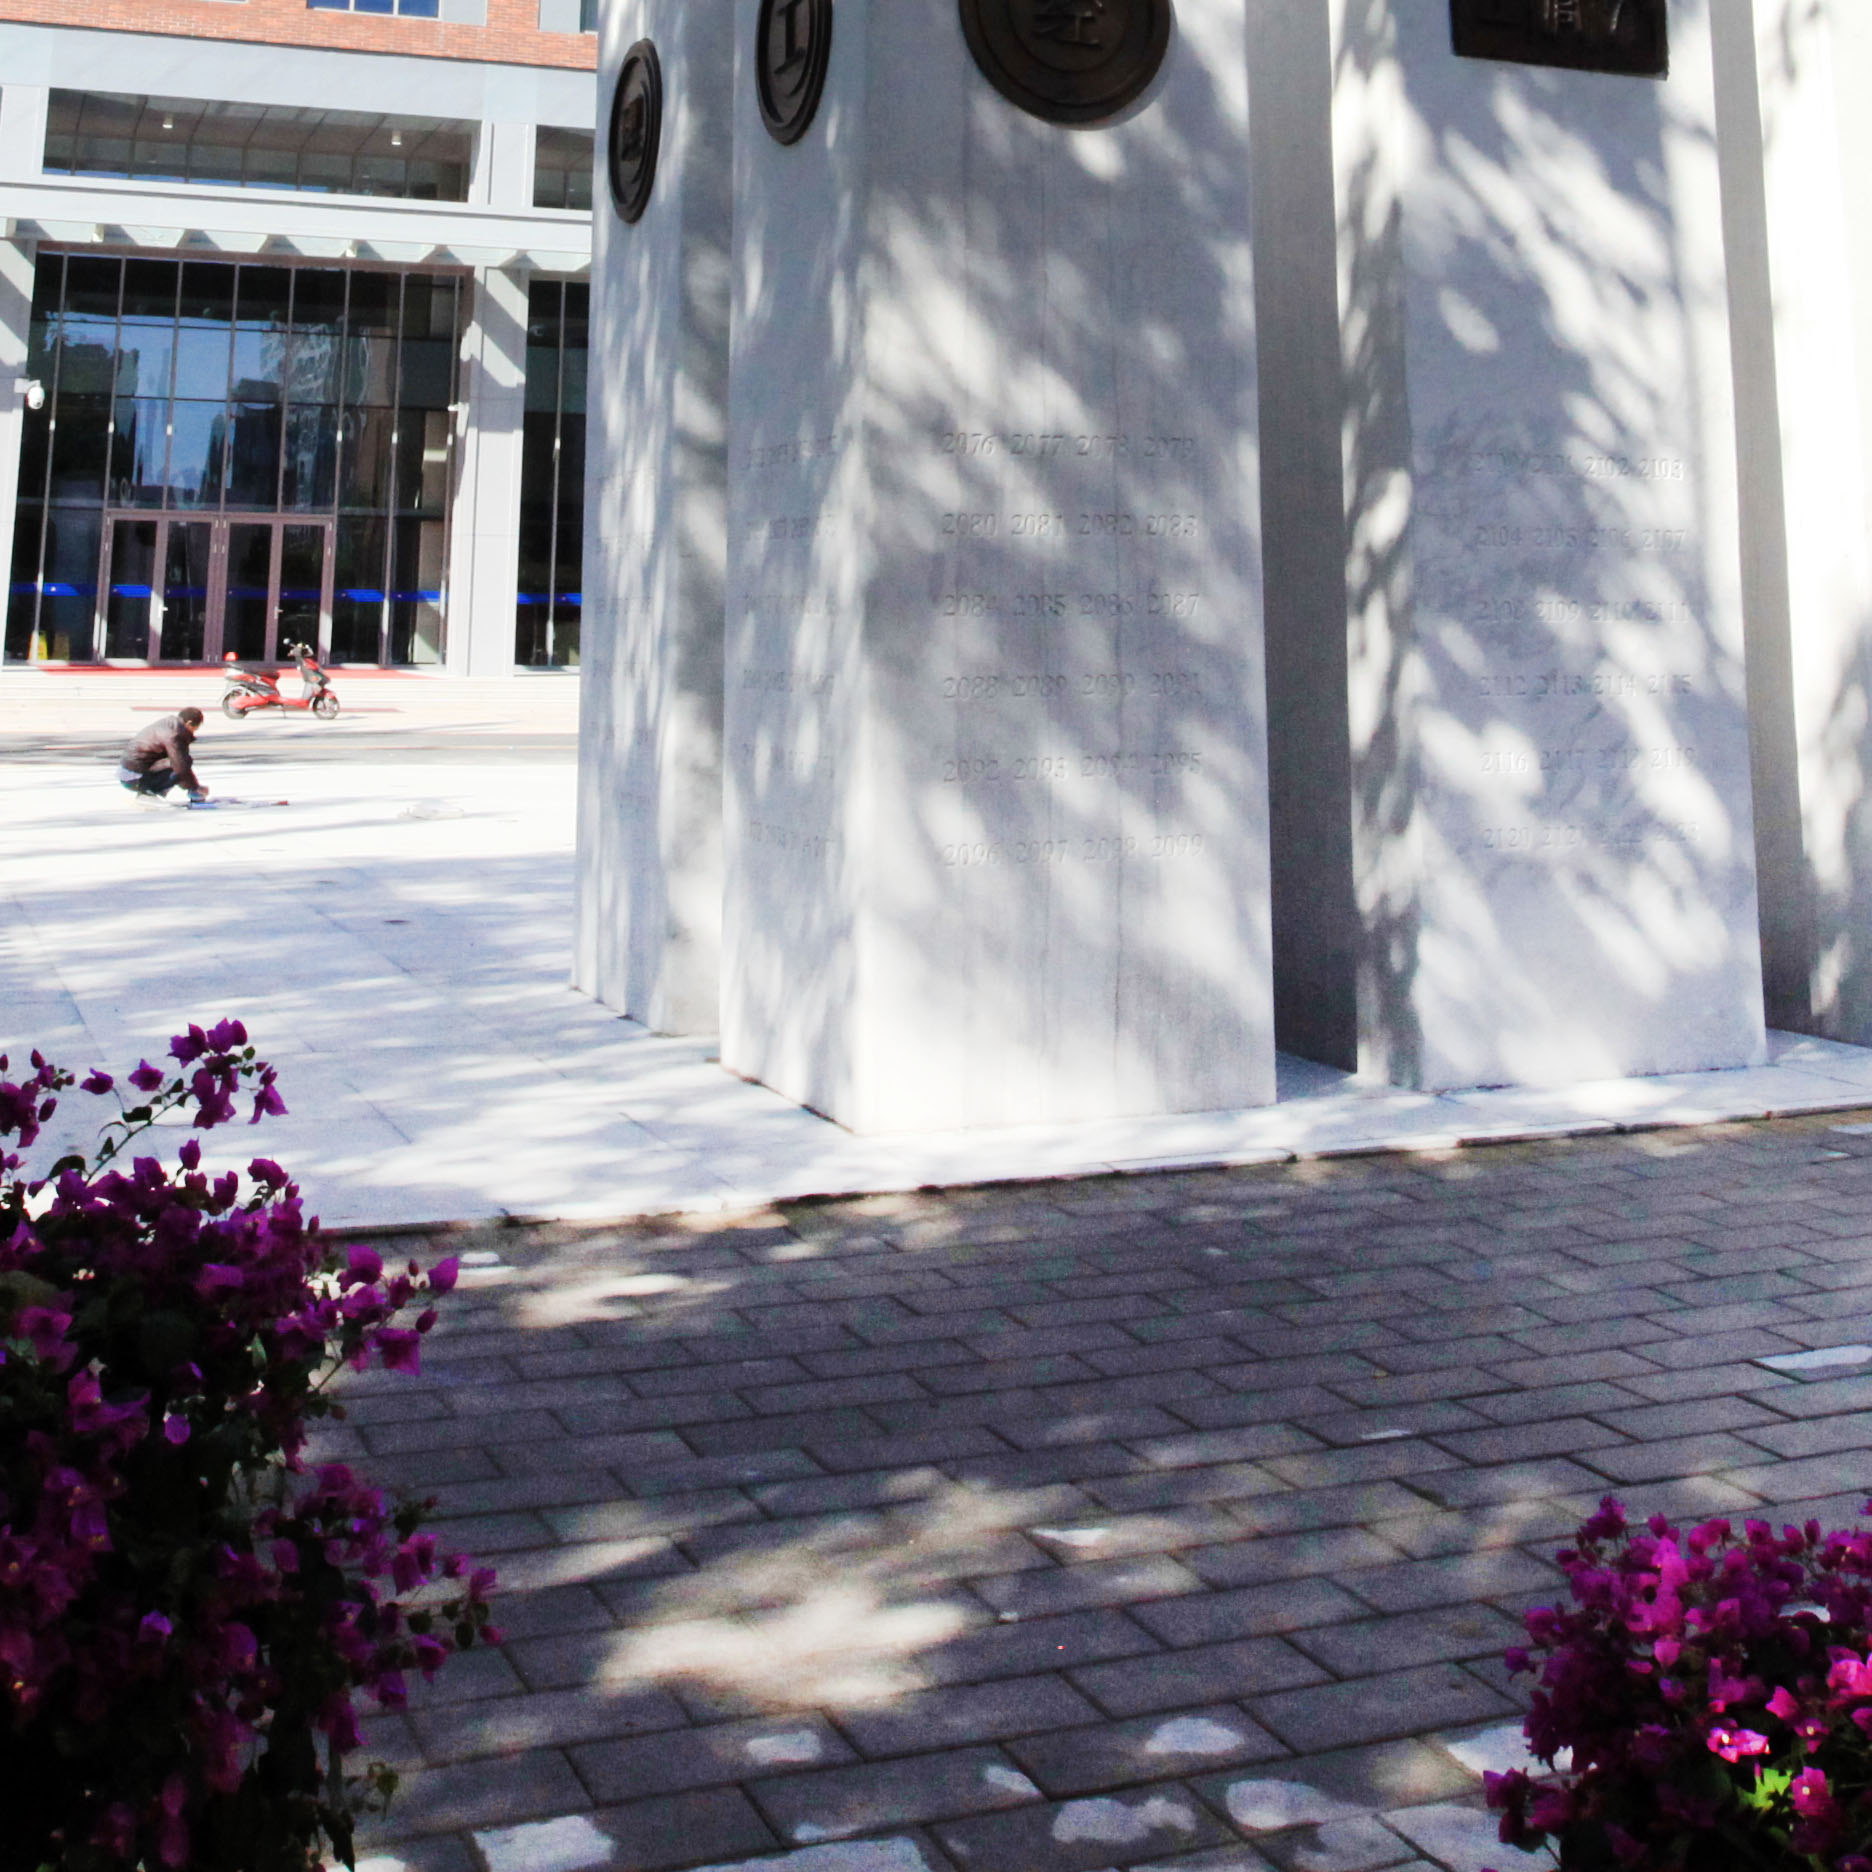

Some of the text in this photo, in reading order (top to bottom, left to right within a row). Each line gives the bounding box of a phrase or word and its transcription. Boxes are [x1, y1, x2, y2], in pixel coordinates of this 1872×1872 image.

[942, 432, 996, 456] 2076
[1010, 434, 1064, 456] 2077
[942, 513, 1198, 538] 2080 2081 2082 2083
[942, 594, 1000, 616] 2084
[1080, 594, 1134, 616] 2086
[1147, 594, 1200, 617] 2087
[942, 676, 999, 700] 2088
[1012, 675, 1068, 698] 2089
[942, 759, 1000, 782] 2092
[1013, 757, 1068, 780] 2093
[1149, 752, 1202, 776] 2095
[943, 834, 1204, 868] 2096 2097 2098 2099
